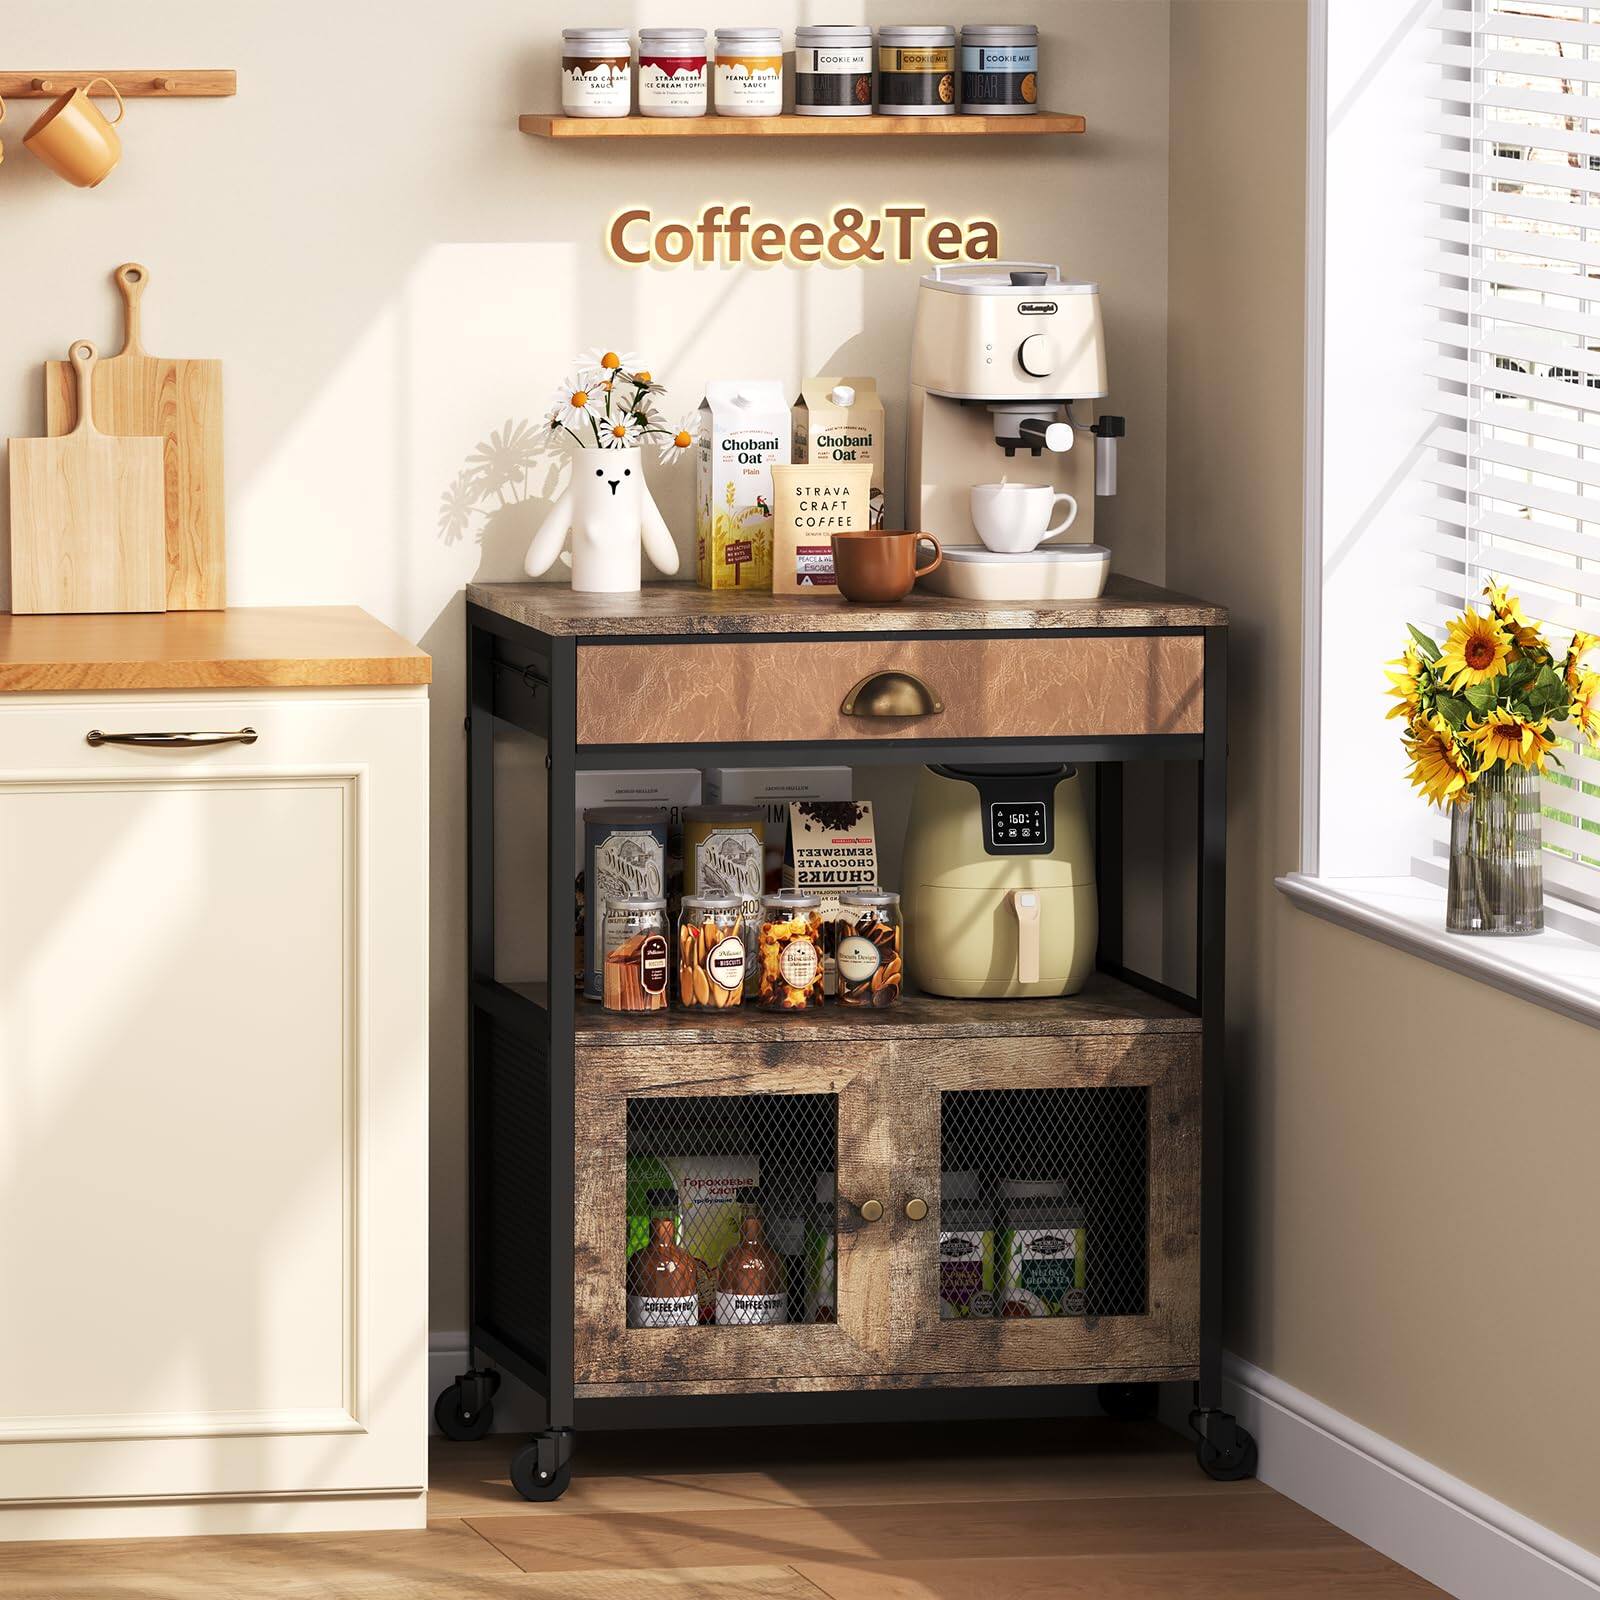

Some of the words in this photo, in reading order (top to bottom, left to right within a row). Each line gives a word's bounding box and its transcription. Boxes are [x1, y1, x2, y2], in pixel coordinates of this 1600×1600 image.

[610, 206, 998, 263] Coffee&Tea
[722, 438, 778, 450] Chobani
[816, 434, 872, 448] Chobani
[738, 452, 762, 464] Oat
[832, 448, 856, 460] Oat
[796, 487, 850, 496] STRAVA
[800, 501, 847, 511] CRAFT
[794, 516, 852, 527] COFFEE
[683, 1178, 754, 1189] Гороховые
